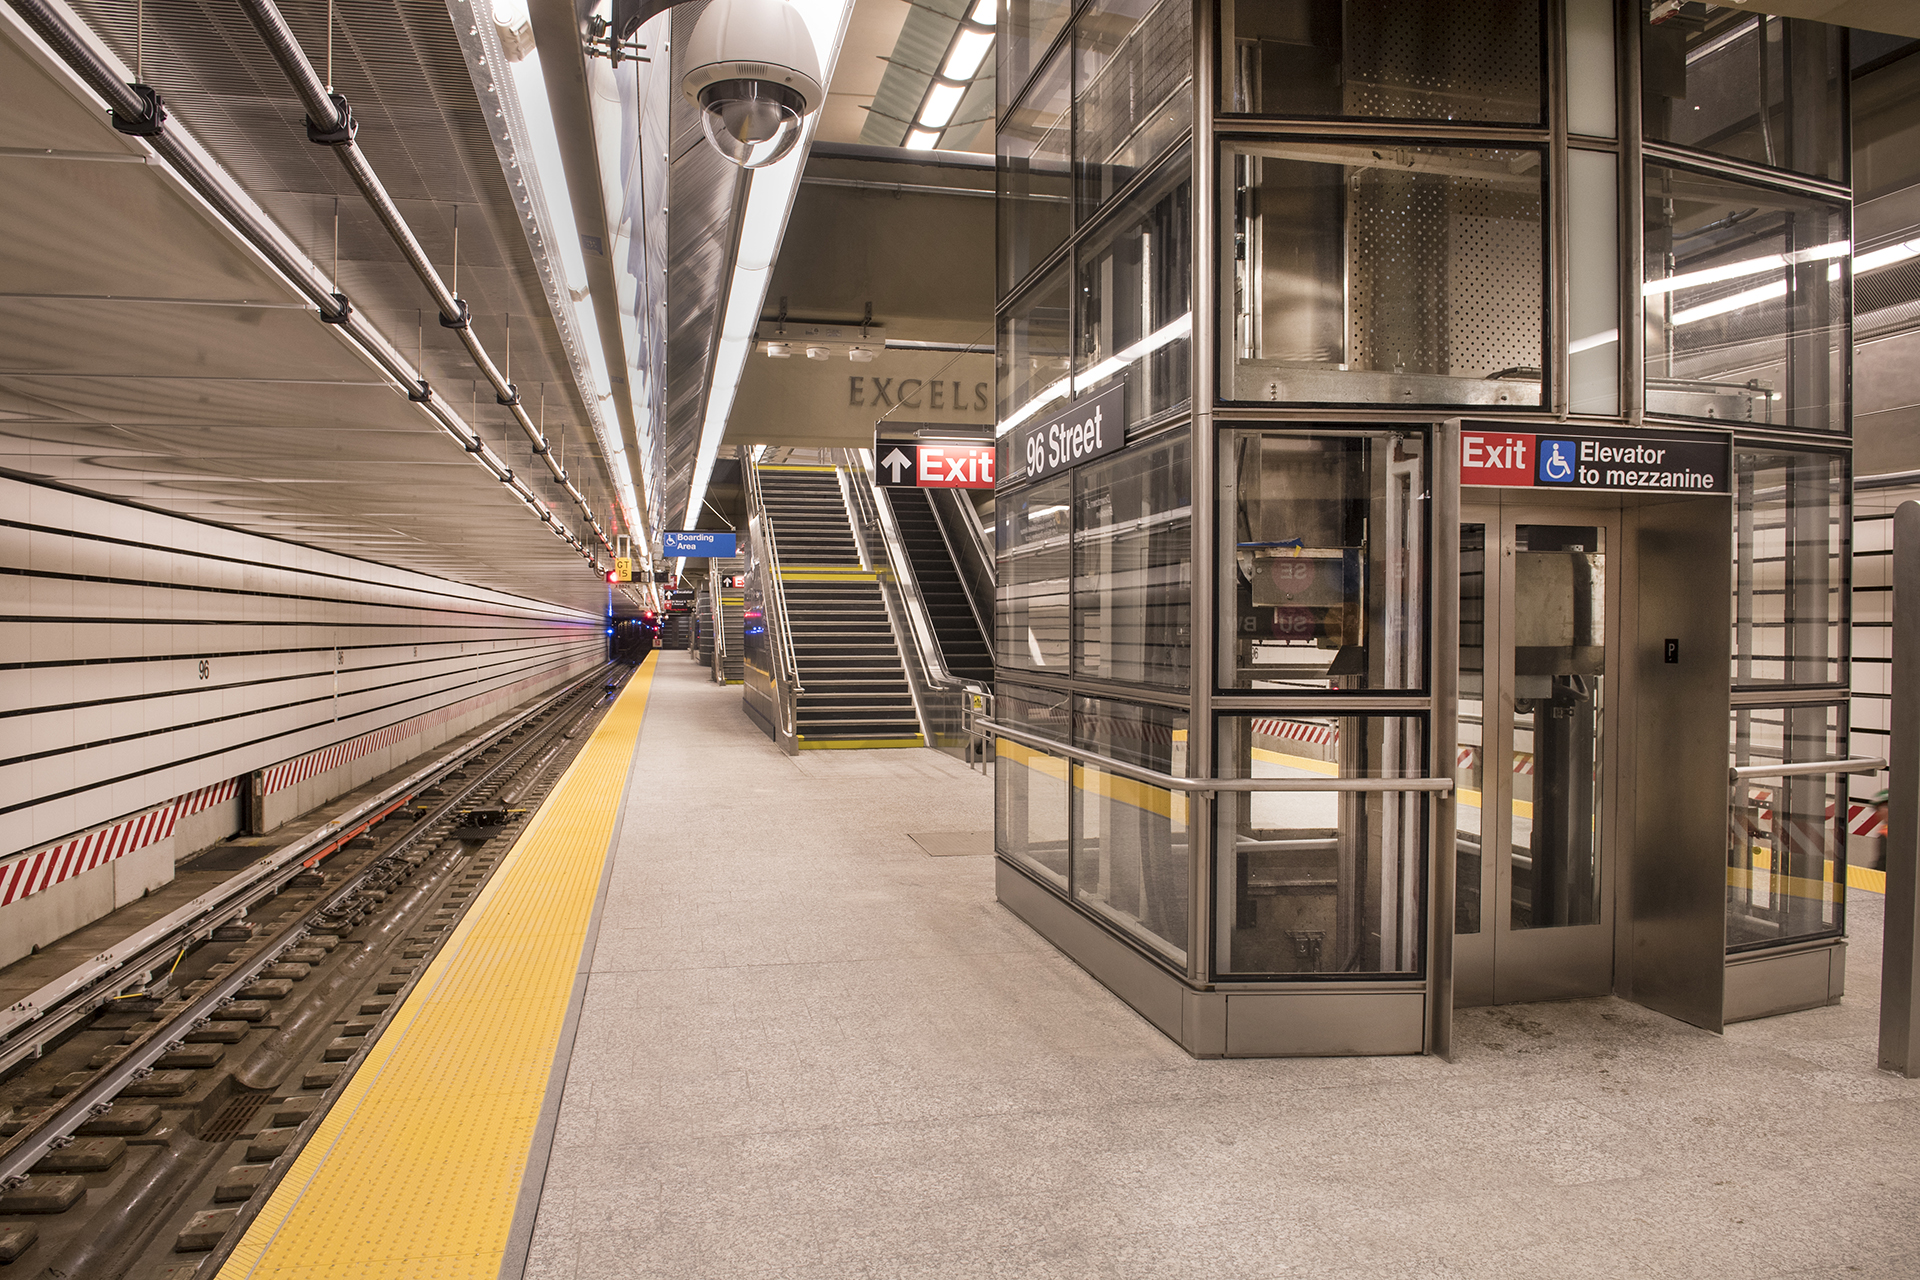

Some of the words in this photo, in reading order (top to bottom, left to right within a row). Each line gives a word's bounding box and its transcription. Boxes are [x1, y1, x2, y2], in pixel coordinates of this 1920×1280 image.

[848, 376, 988, 411] EXCELS
[1026, 431, 1045, 477] 96
[1049, 405, 1103, 468] Street
[1462, 436, 1527, 469] Exit
[1579, 441, 1666, 465] Elevator
[919, 448, 993, 483] Exit
[1578, 465, 1600, 485] to
[1606, 468, 1714, 489] mezzanine
[677, 533, 714, 542] Boarding
[198, 660, 210, 680] 96
